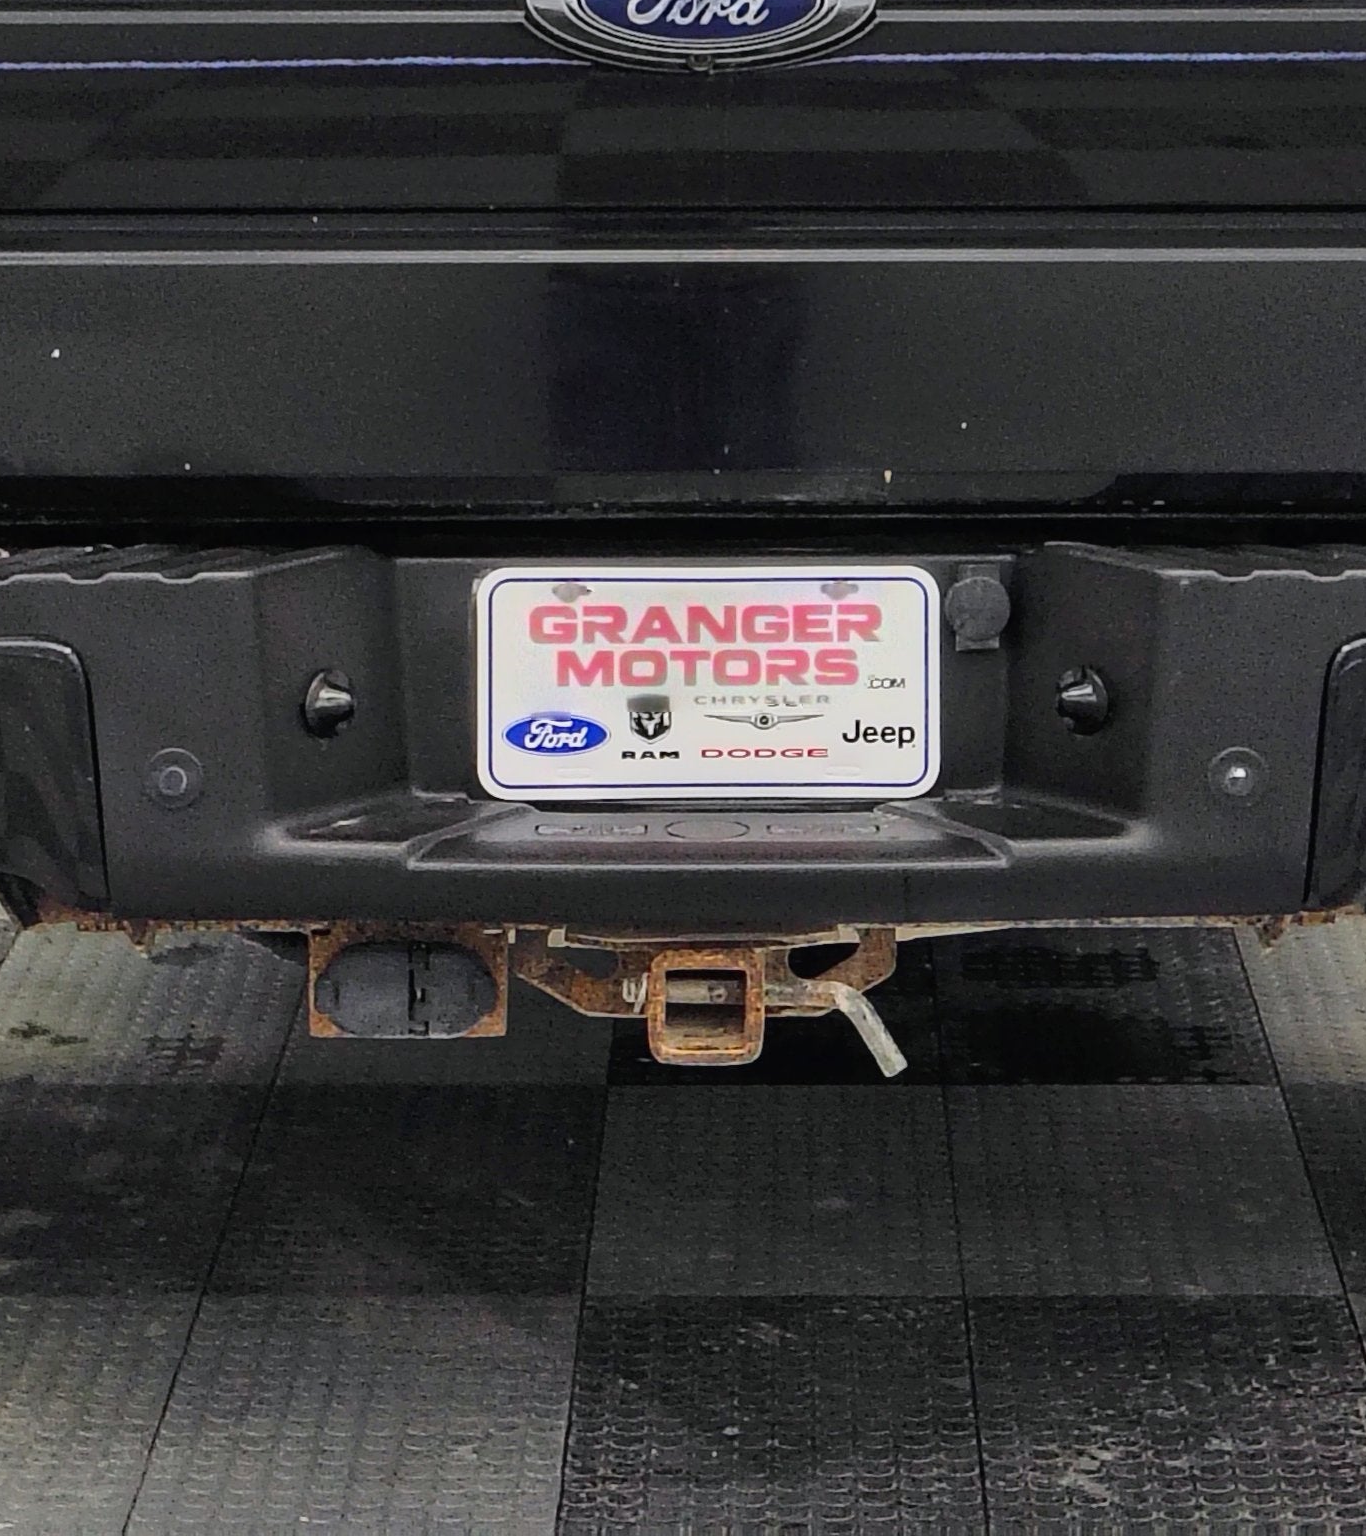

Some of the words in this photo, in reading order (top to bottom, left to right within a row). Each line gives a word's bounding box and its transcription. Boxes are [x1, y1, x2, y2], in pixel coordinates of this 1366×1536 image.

[528, 603, 883, 644] GRANGER
[556, 648, 860, 687] MOTORS
[693, 694, 831, 707] CHRYSLER
[524, 719, 589, 749] Ford
[841, 719, 916, 749] Jeep
[621, 750, 681, 760] RAM
[700, 748, 829, 759] DODGE
